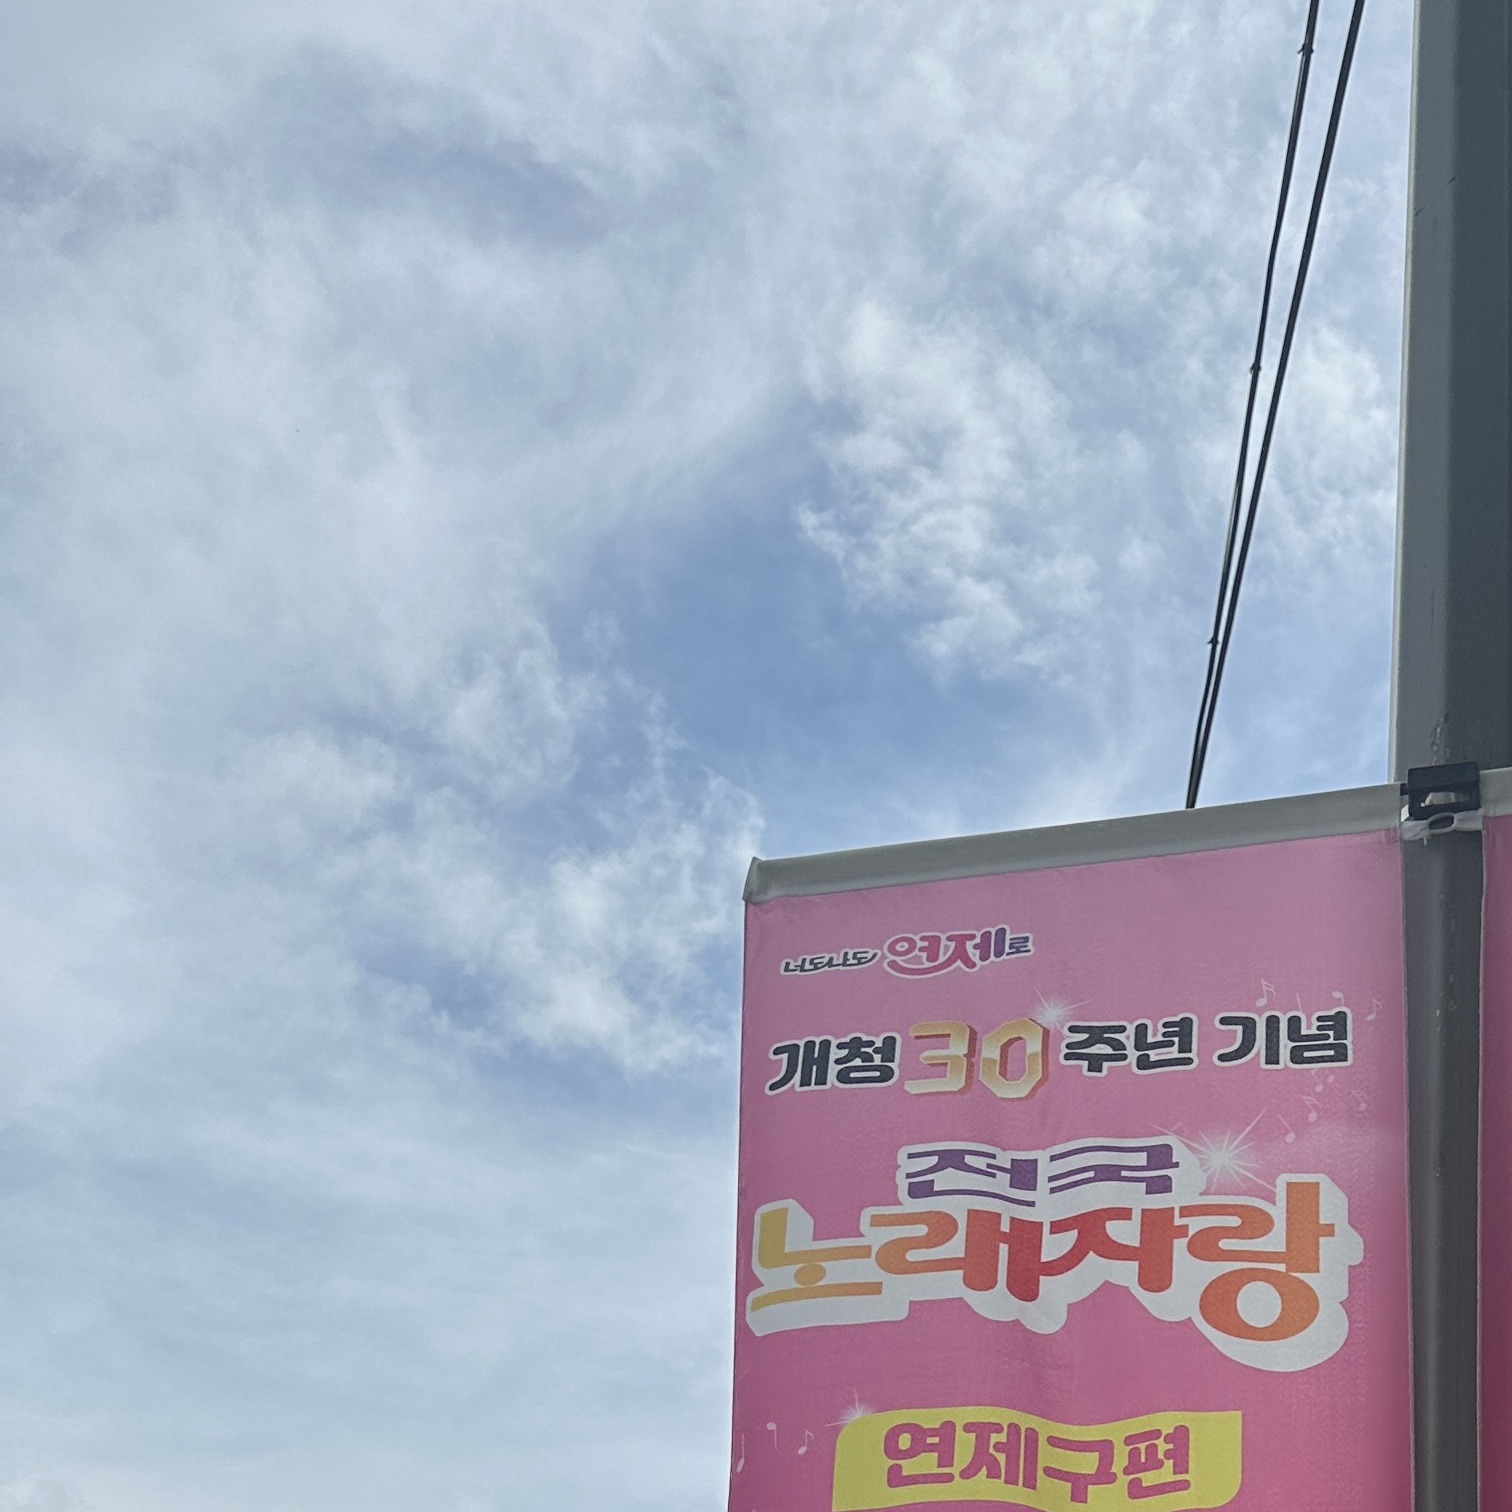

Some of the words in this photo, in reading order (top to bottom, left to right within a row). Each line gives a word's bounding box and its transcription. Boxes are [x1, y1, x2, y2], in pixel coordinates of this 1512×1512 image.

[783, 950, 880, 974] 너도나도
[886, 926, 1033, 976] 연제로
[1215, 1008, 1352, 1068] 기념
[903, 1141, 1182, 1209] 전국
[749, 1181, 1337, 1343] 노래자랑
[882, 1419, 1194, 1504] 연제구편
